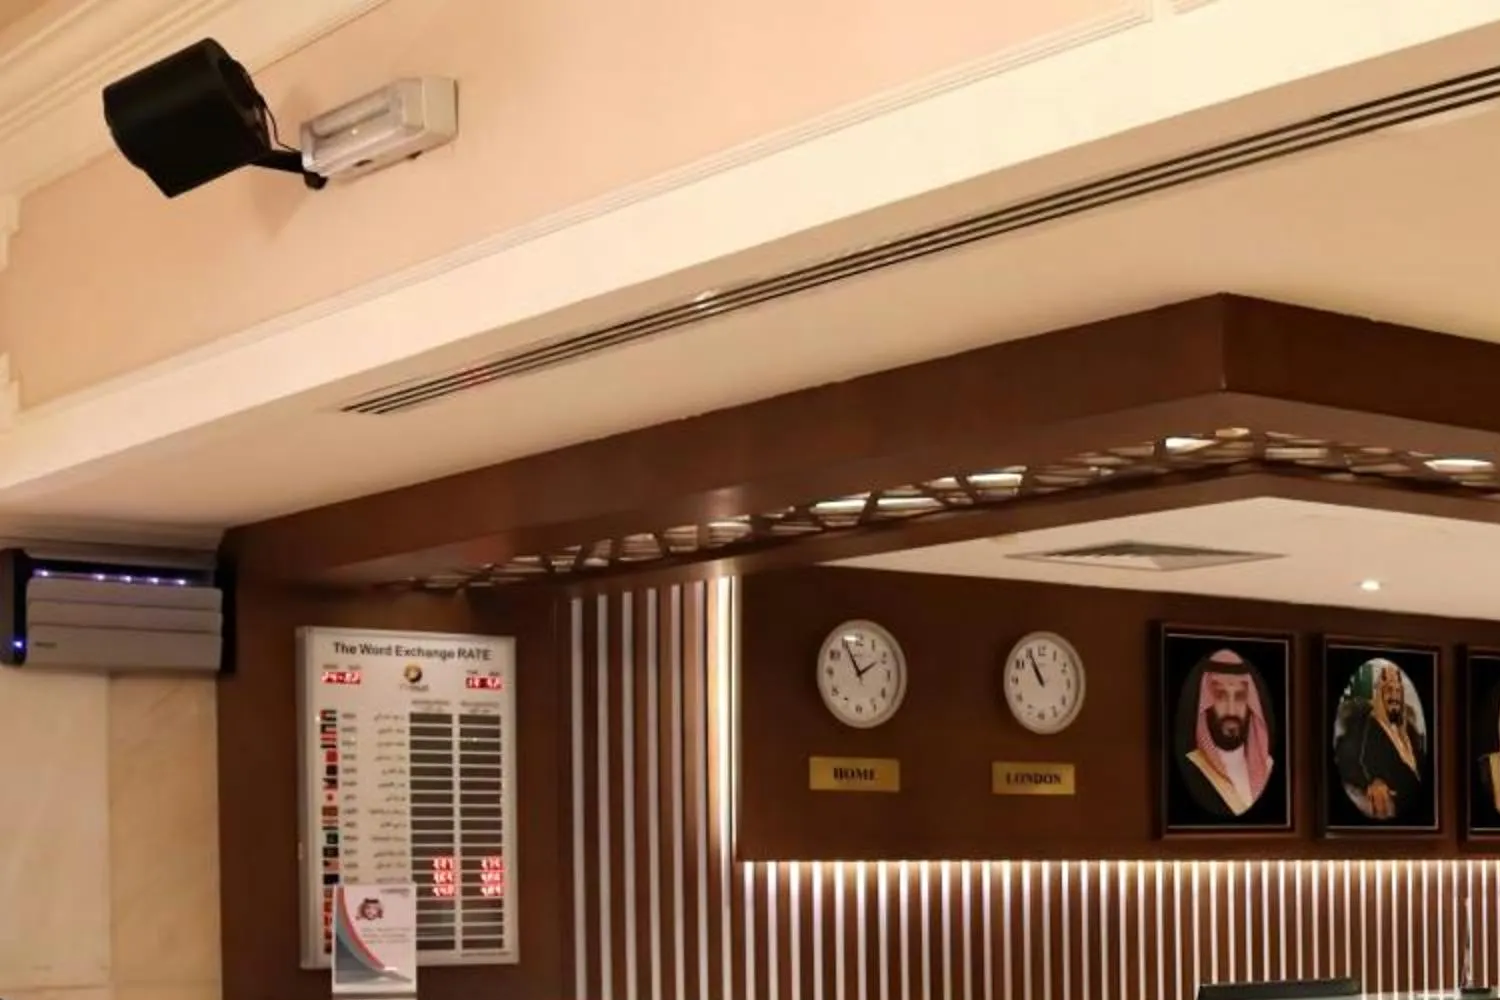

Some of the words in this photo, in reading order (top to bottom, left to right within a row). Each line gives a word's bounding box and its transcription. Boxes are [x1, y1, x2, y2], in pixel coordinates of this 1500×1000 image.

[333, 641, 357, 654] The
[394, 645, 457, 661] Exchange
[457, 647, 493, 661] RATE
[833, 767, 877, 782] HOME
[1006, 771, 1062, 786] LONDON
